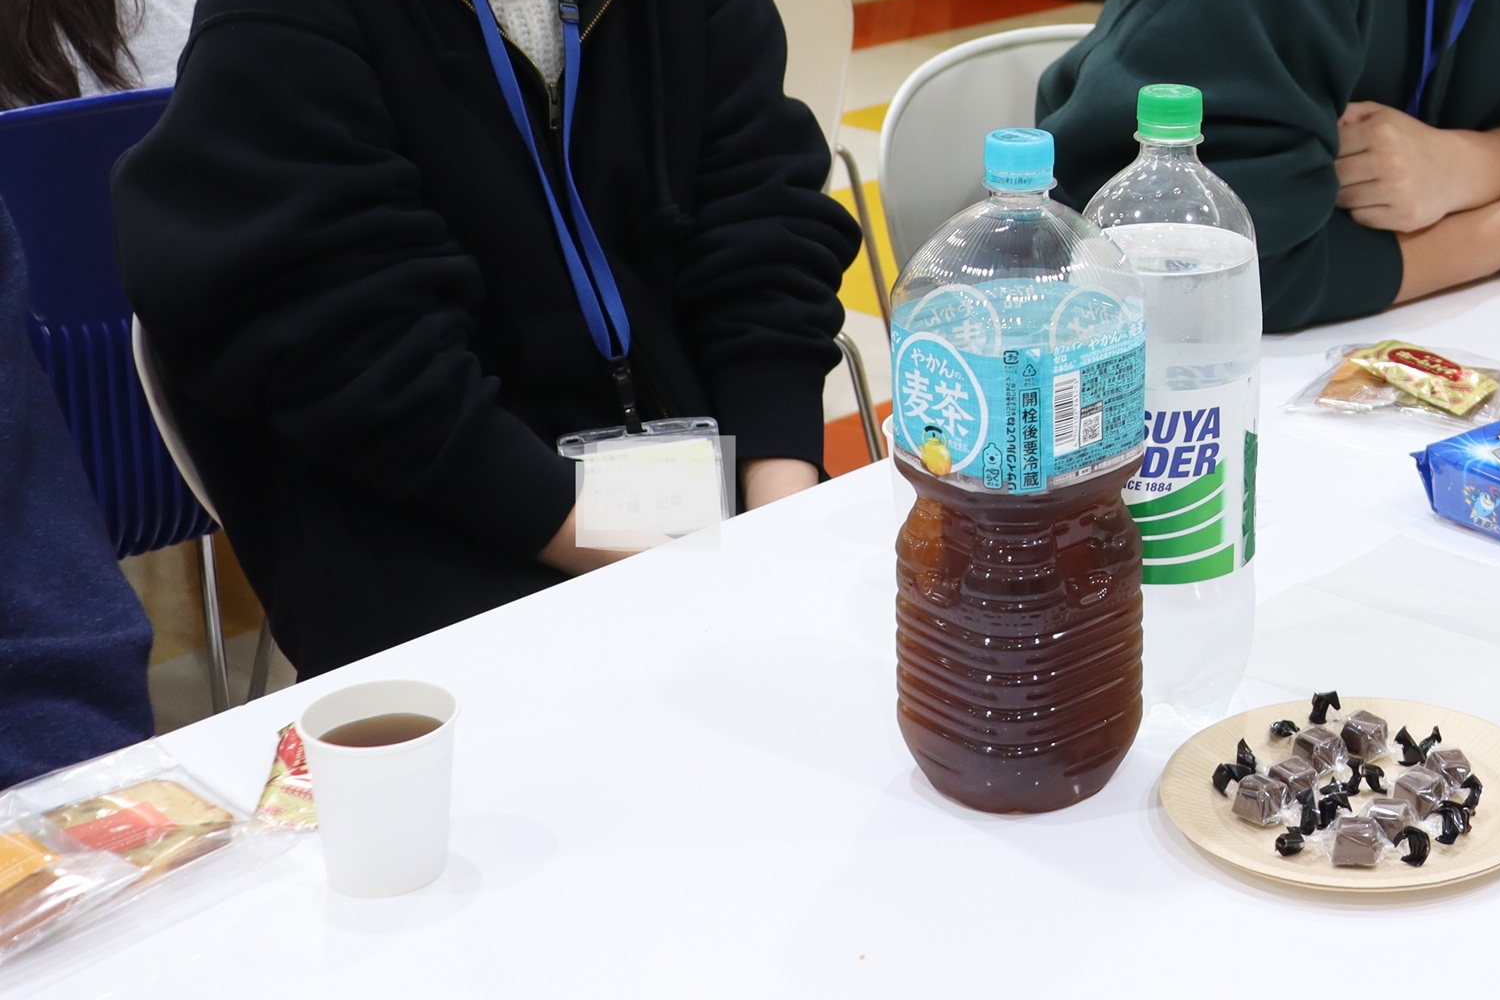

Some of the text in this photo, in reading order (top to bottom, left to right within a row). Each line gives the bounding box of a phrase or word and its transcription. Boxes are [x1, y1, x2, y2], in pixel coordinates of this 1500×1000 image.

[910, 347, 965, 381] やかんの、
[1053, 340, 1082, 355] カフェイン
[1053, 354, 1068, 364] ゼロ
[901, 368, 975, 437] 麦茶
[1006, 417, 1017, 491] リサイクルしてね
[1021, 391, 1040, 488] 開栓後要冷蔵
[1145, 481, 1172, 492] 1884
